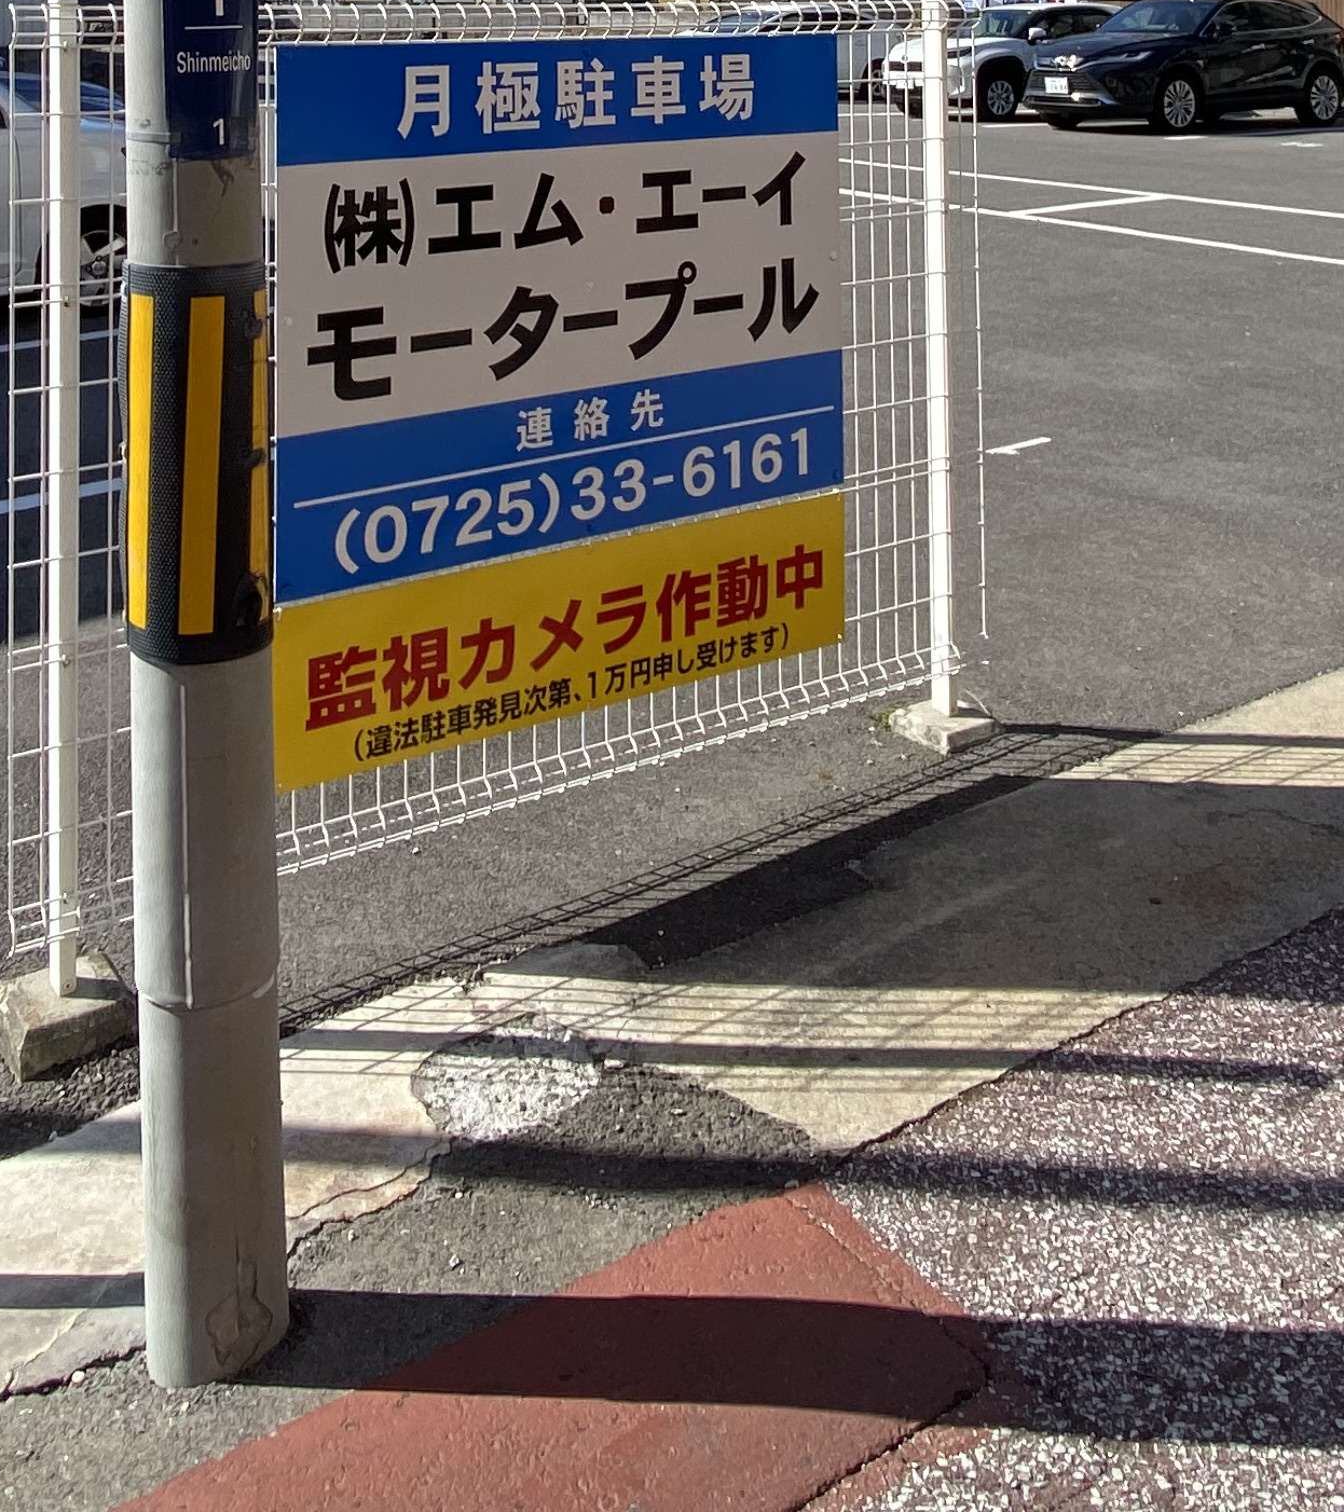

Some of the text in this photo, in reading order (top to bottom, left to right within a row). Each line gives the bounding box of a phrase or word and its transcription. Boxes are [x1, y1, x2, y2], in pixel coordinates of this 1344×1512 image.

[176, 49, 251, 74] Shinmeicho
[397, 54, 755, 140] 月極駐車場
[212, 117, 225, 146] 1
[306, 257, 820, 402] モータープール
[516, 389, 665, 452] 連絡先
[334, 427, 810, 575] (0725)33-6161
[305, 543, 825, 732] 監視カメラ作動中
